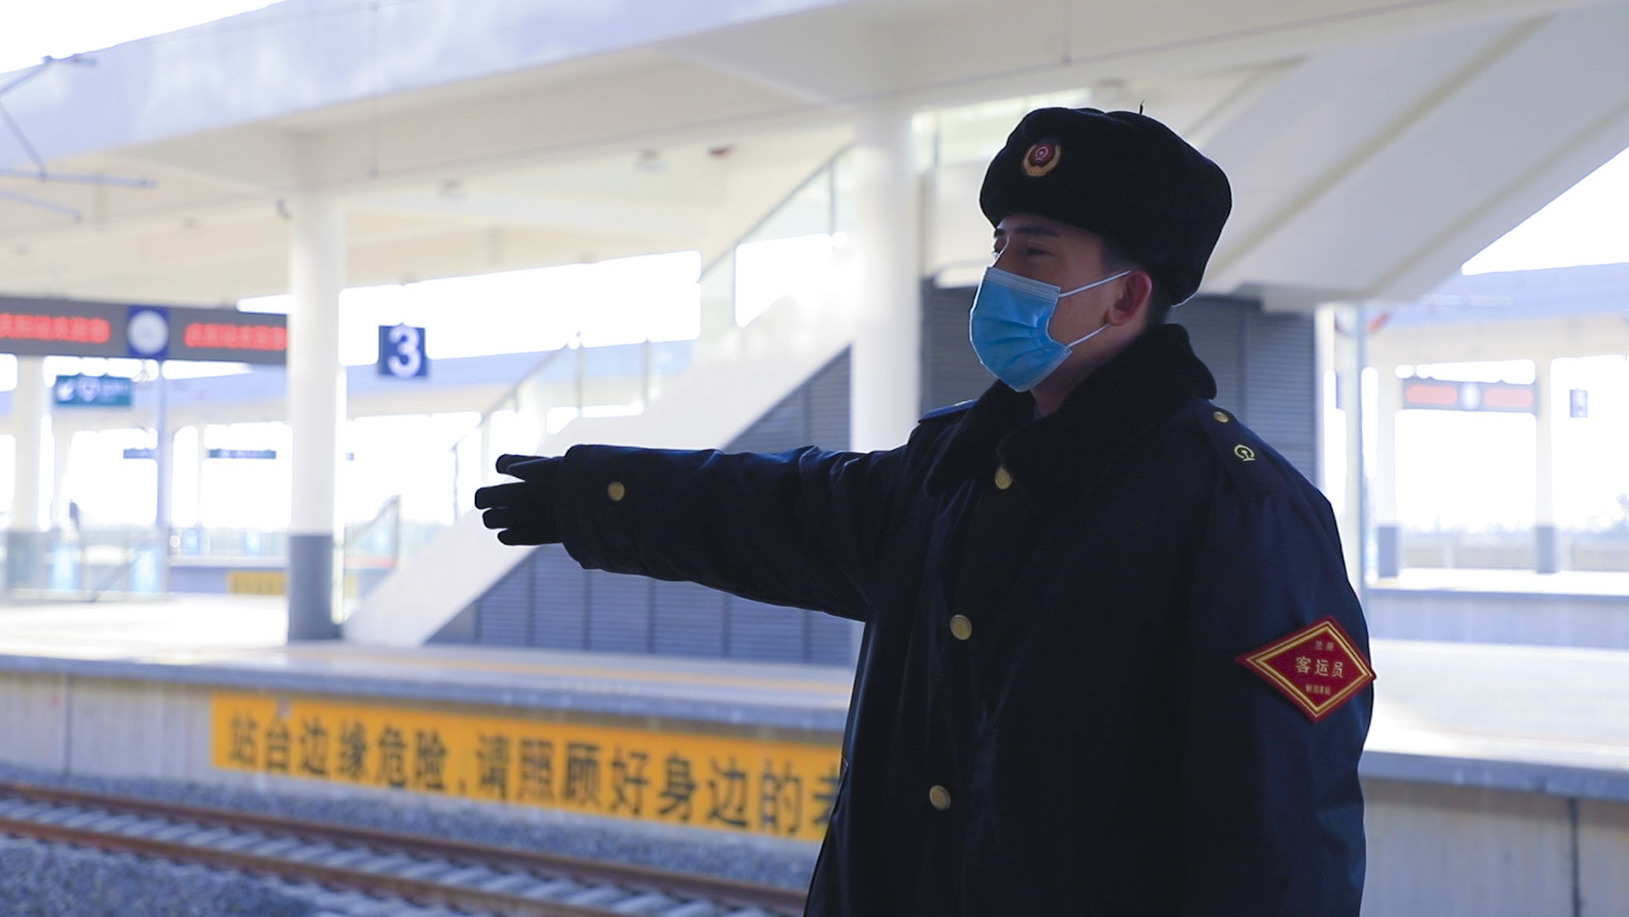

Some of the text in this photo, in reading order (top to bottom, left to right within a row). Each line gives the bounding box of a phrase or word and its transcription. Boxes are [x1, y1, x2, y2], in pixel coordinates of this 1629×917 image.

[388, 325, 421, 377] 3
[1296, 656, 1344, 679] 客运员
